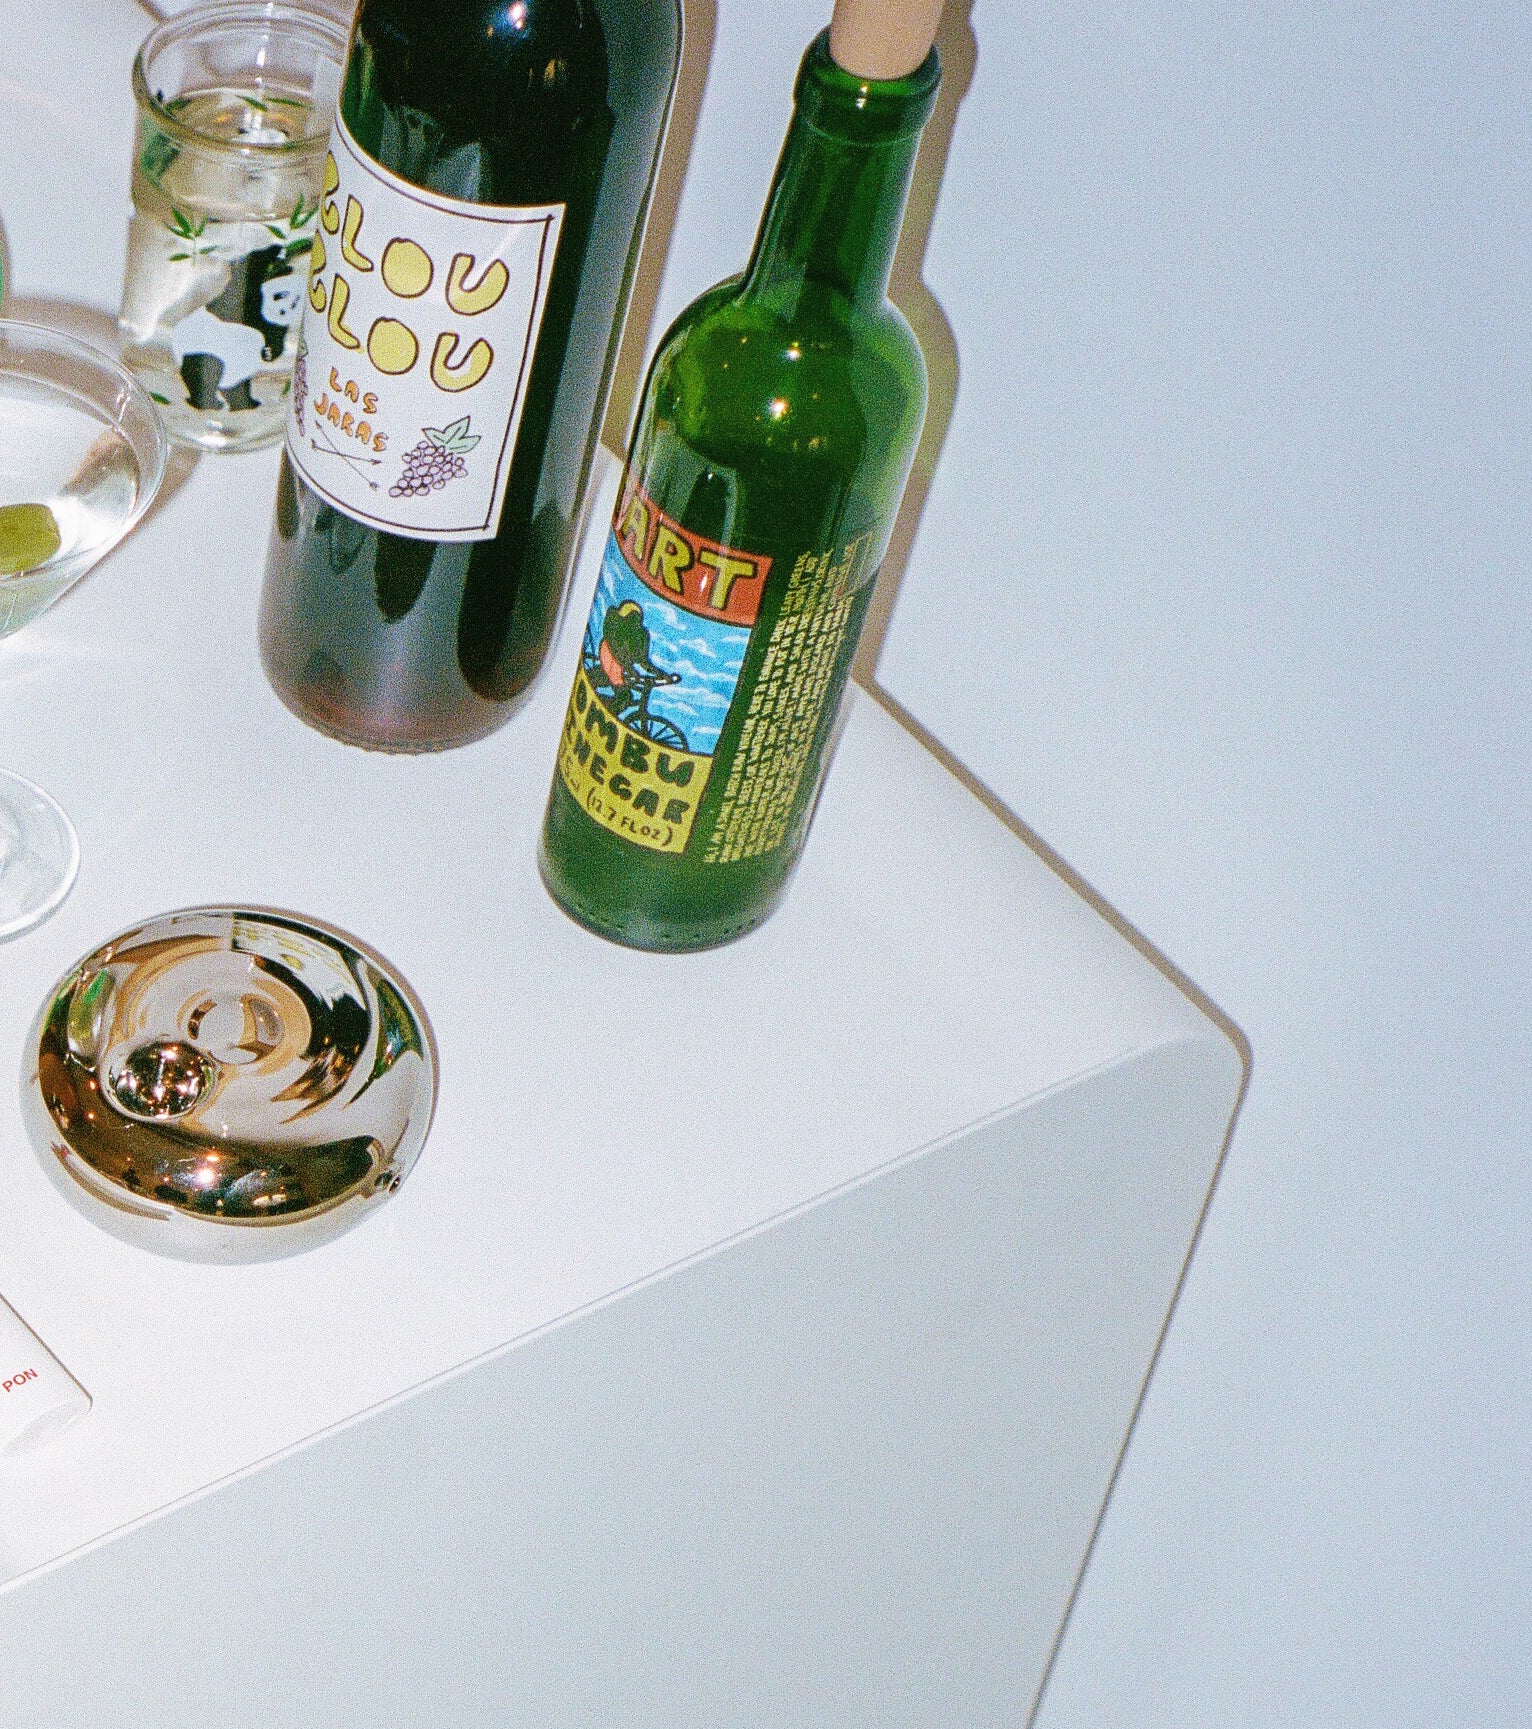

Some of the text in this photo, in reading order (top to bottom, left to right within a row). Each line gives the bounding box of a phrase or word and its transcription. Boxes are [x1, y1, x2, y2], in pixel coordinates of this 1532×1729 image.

[330, 366, 379, 414] LAS
[313, 395, 390, 453] JARAS
[574, 678, 696, 788] OMBU
[1, 1367, 39, 1393] PON
